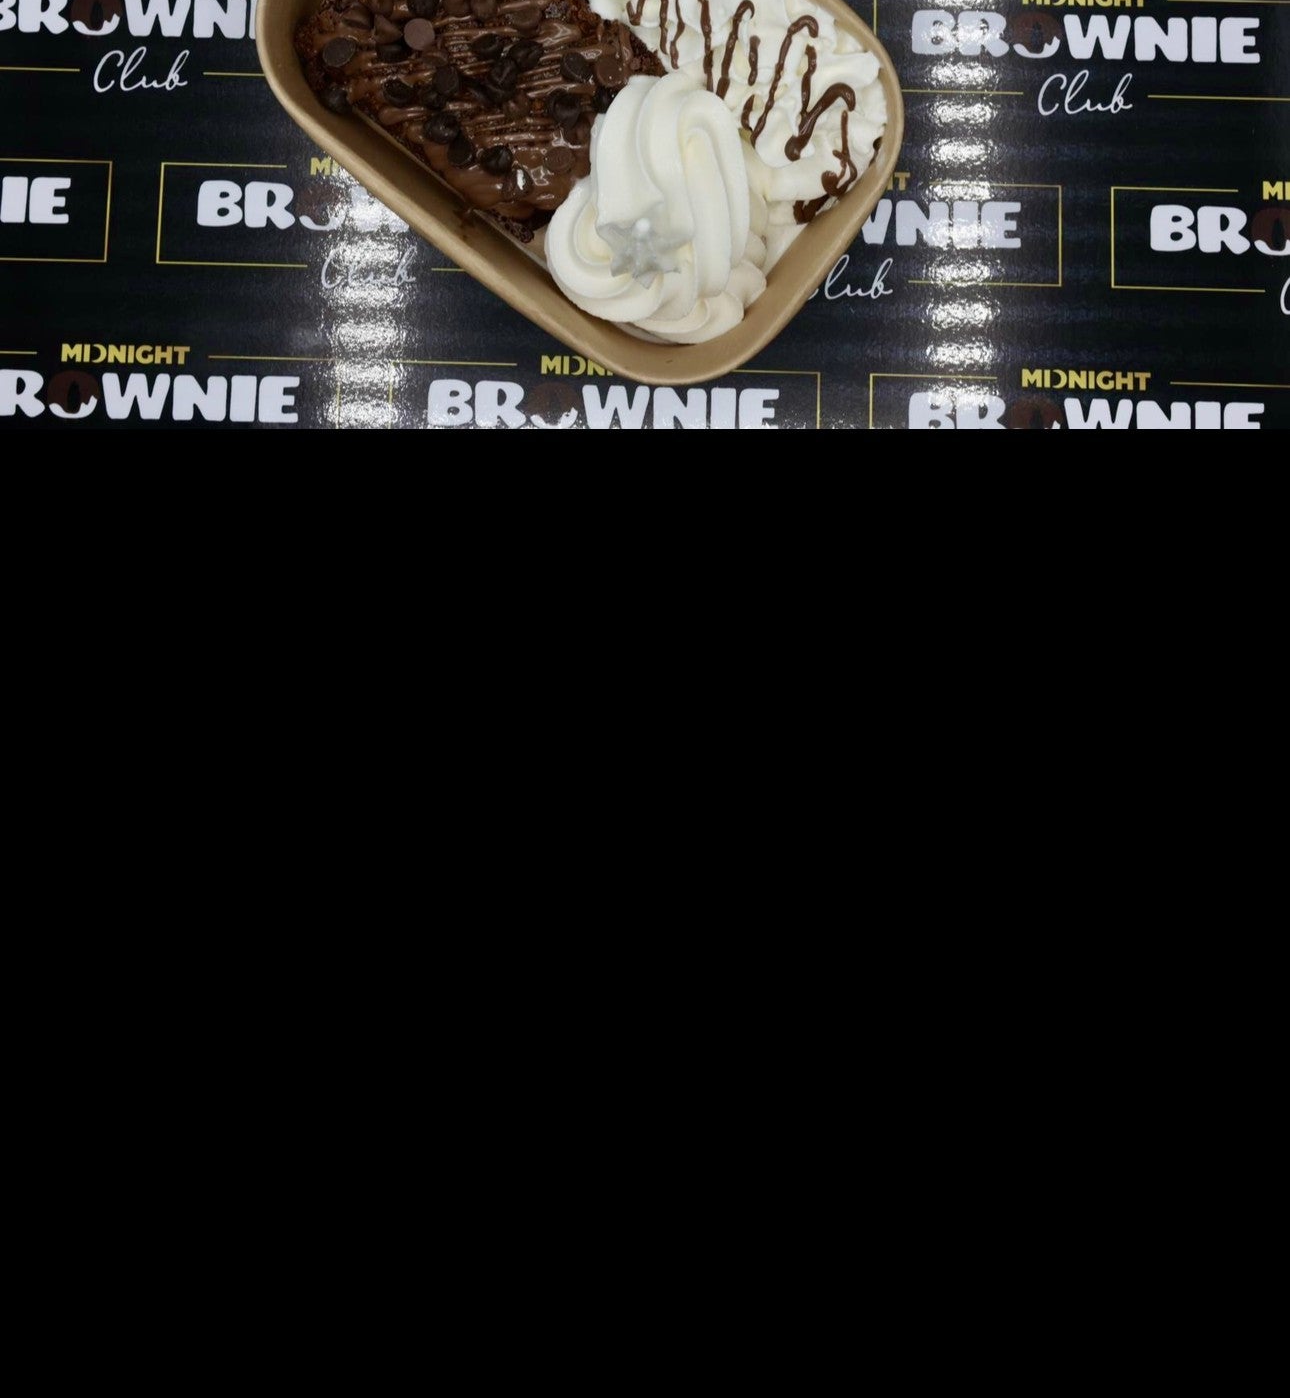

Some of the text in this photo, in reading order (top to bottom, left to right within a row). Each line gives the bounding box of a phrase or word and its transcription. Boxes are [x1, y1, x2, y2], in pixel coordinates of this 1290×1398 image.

[911, 9, 1261, 64] BROWNIE
[93, 46, 190, 93] Club
[1037, 69, 1133, 116] Club
[61, 343, 191, 365] MIDNIGHT
[1021, 368, 1151, 391] MIDNIGHT
[427, 379, 780, 429] BROWNIE
